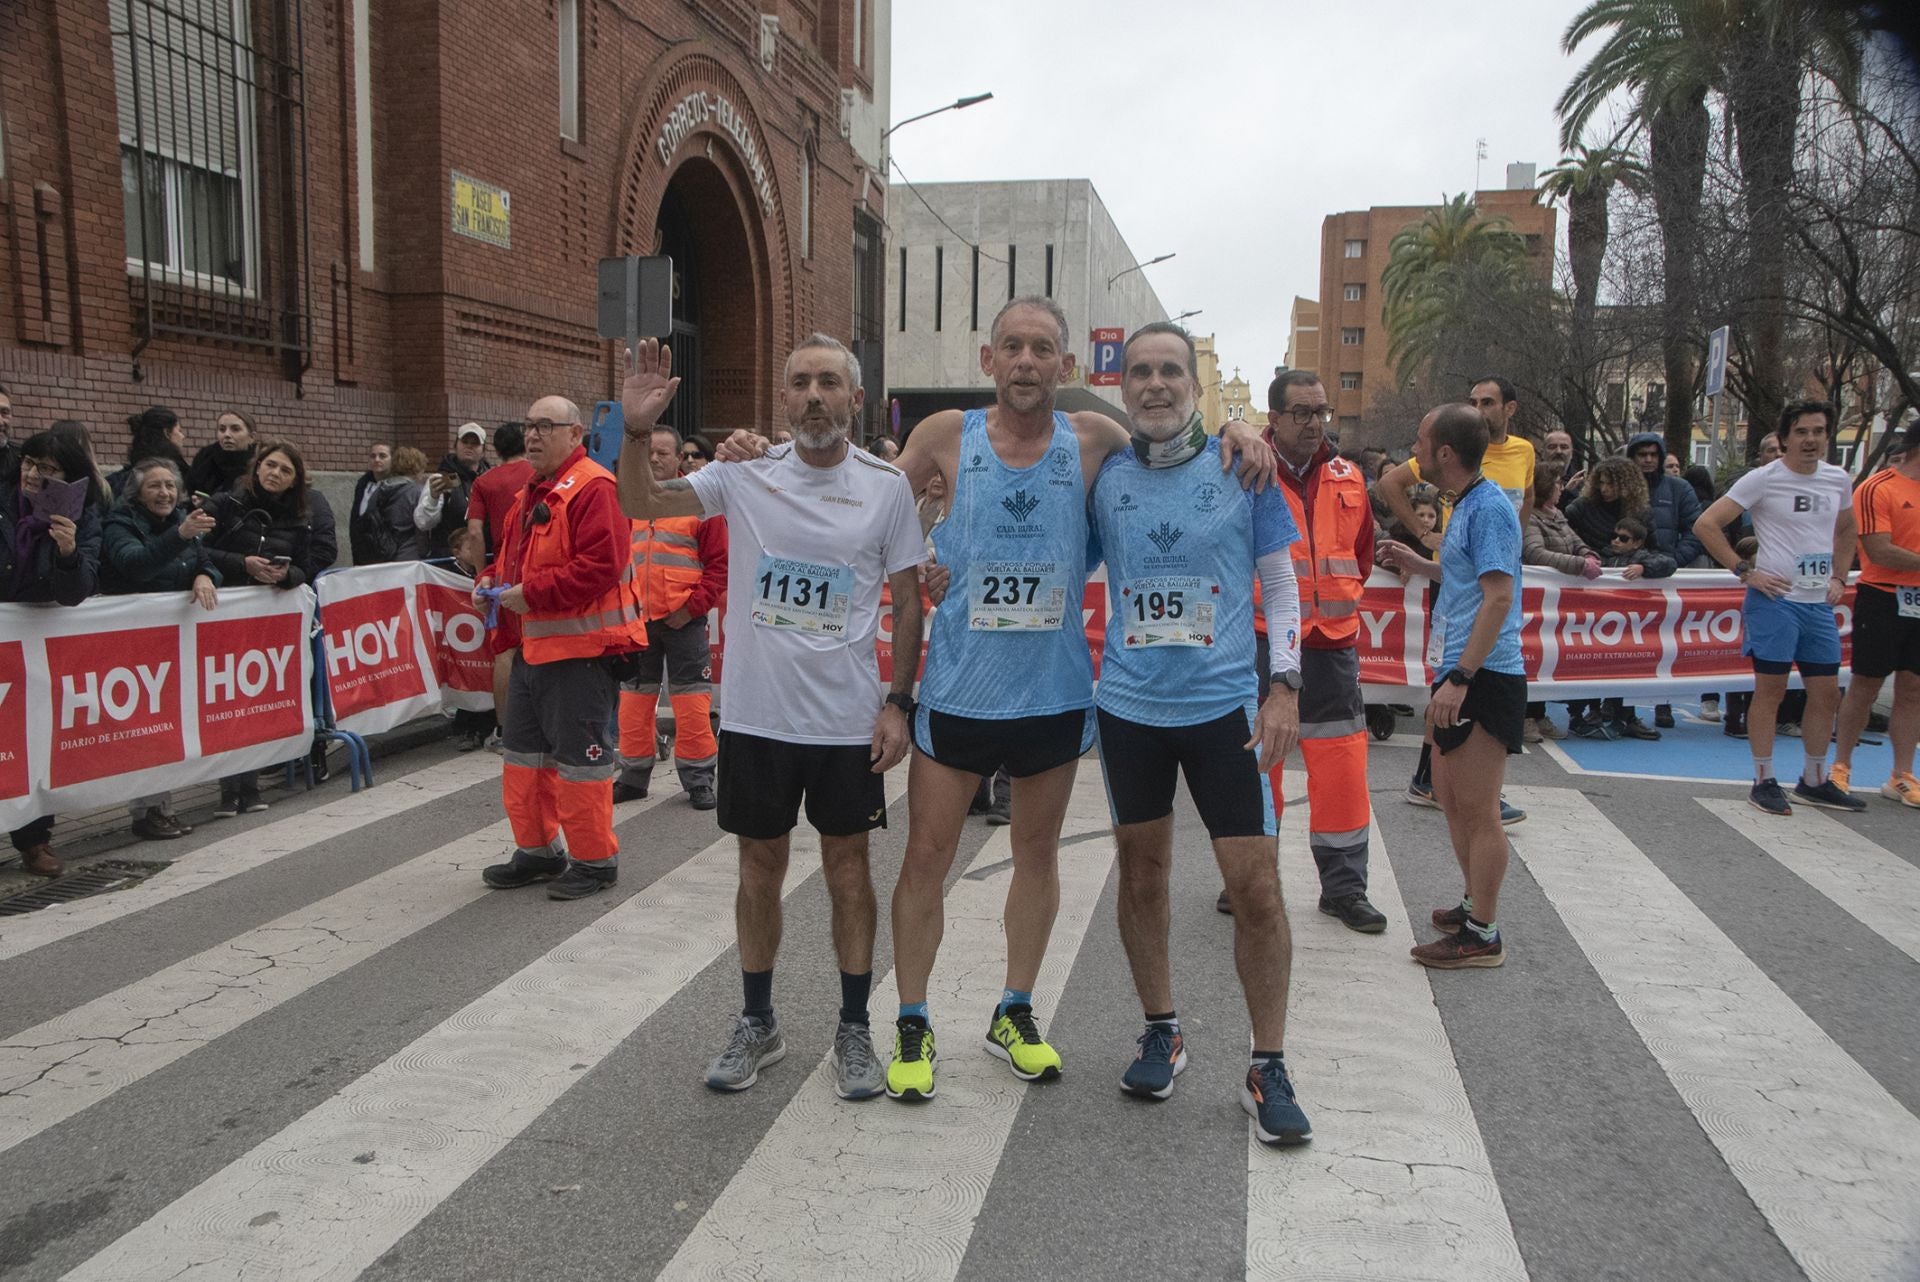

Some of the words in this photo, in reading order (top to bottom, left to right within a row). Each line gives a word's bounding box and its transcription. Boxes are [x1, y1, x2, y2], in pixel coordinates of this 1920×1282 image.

[1101, 331, 1117, 340] Dia
[1102, 345, 1115, 371] P
[1710, 337, 1720, 386] P
[820, 495, 836, 503] JUAN
[837, 496, 863, 507] ENRIQUE
[997, 525, 1016, 533] CAJA
[1018, 524, 1045, 532] RURAL
[1144, 556, 1161, 564] CAJA
[760, 571, 829, 609] 1131
[983, 576, 1040, 605] 237
[1134, 591, 1183, 621] 195
[424, 608, 486, 653] HO
[823, 623, 843, 632] HOY
[1562, 611, 1658, 646] HOY
[1681, 609, 1743, 643] HO
[324, 615, 400, 677] HOY
[1359, 655, 1395, 663] MADURA
[1604, 651, 1656, 660] EXTREMADURA
[205, 645, 295, 704] HOY
[335, 680, 357, 693] DIARIO
[358, 676, 367, 684] DE
[61, 662, 171, 730] HOY
[206, 710, 233, 723] DIARIO
[235, 708, 246, 718] DE
[247, 698, 296, 716] EXTREMADURA
[60, 735, 96, 751] DIARIO
[98, 733, 111, 744] DE
[113, 721, 174, 742] EXTREMADURA
